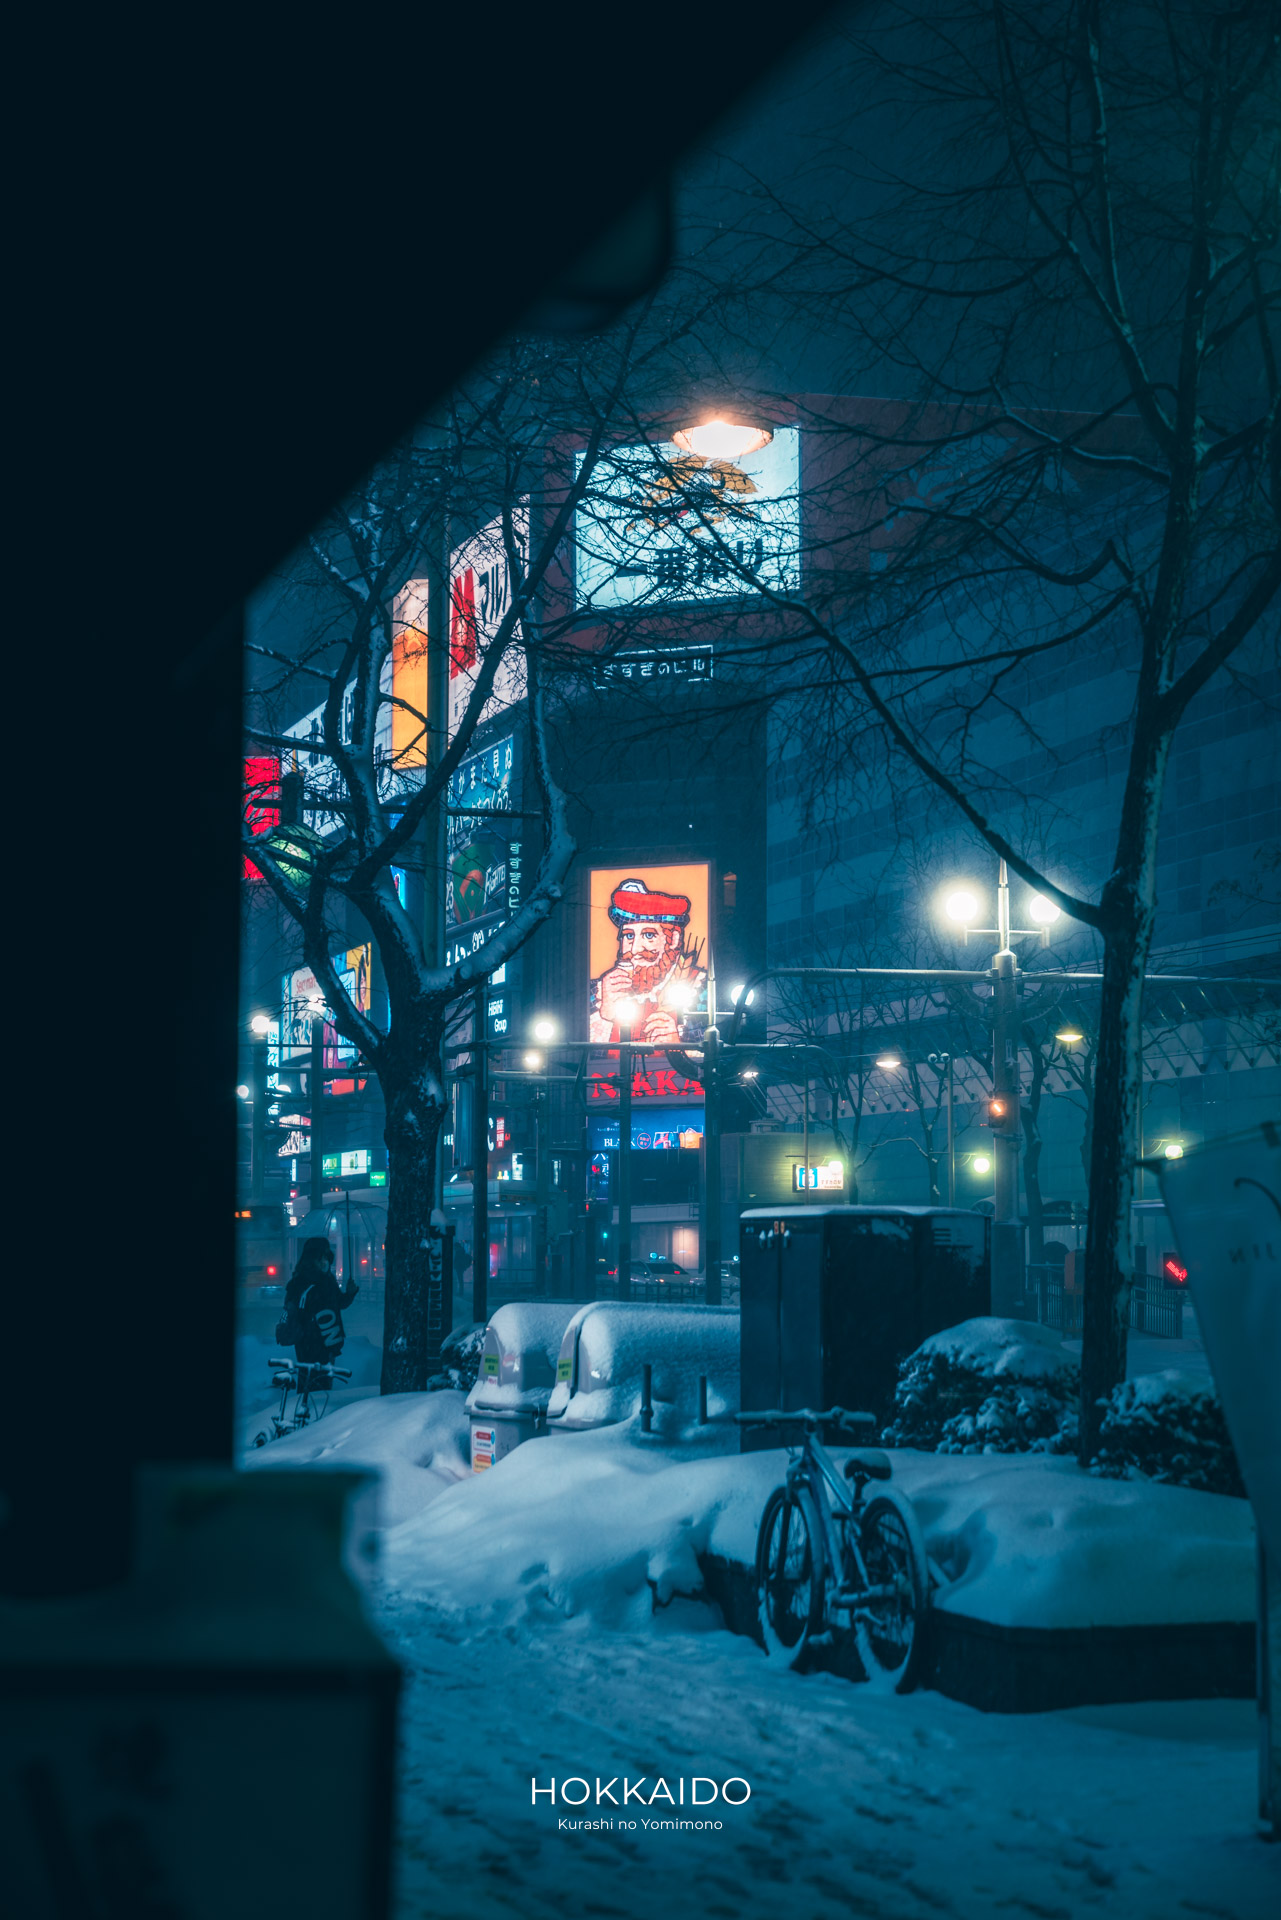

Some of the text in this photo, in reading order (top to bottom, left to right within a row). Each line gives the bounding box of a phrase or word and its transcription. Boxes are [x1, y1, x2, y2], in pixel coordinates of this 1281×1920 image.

[508, 842, 523, 917] すすきのビ
[591, 1070, 706, 1099] NKKA
[604, 1137, 636, 1147] BLAK
